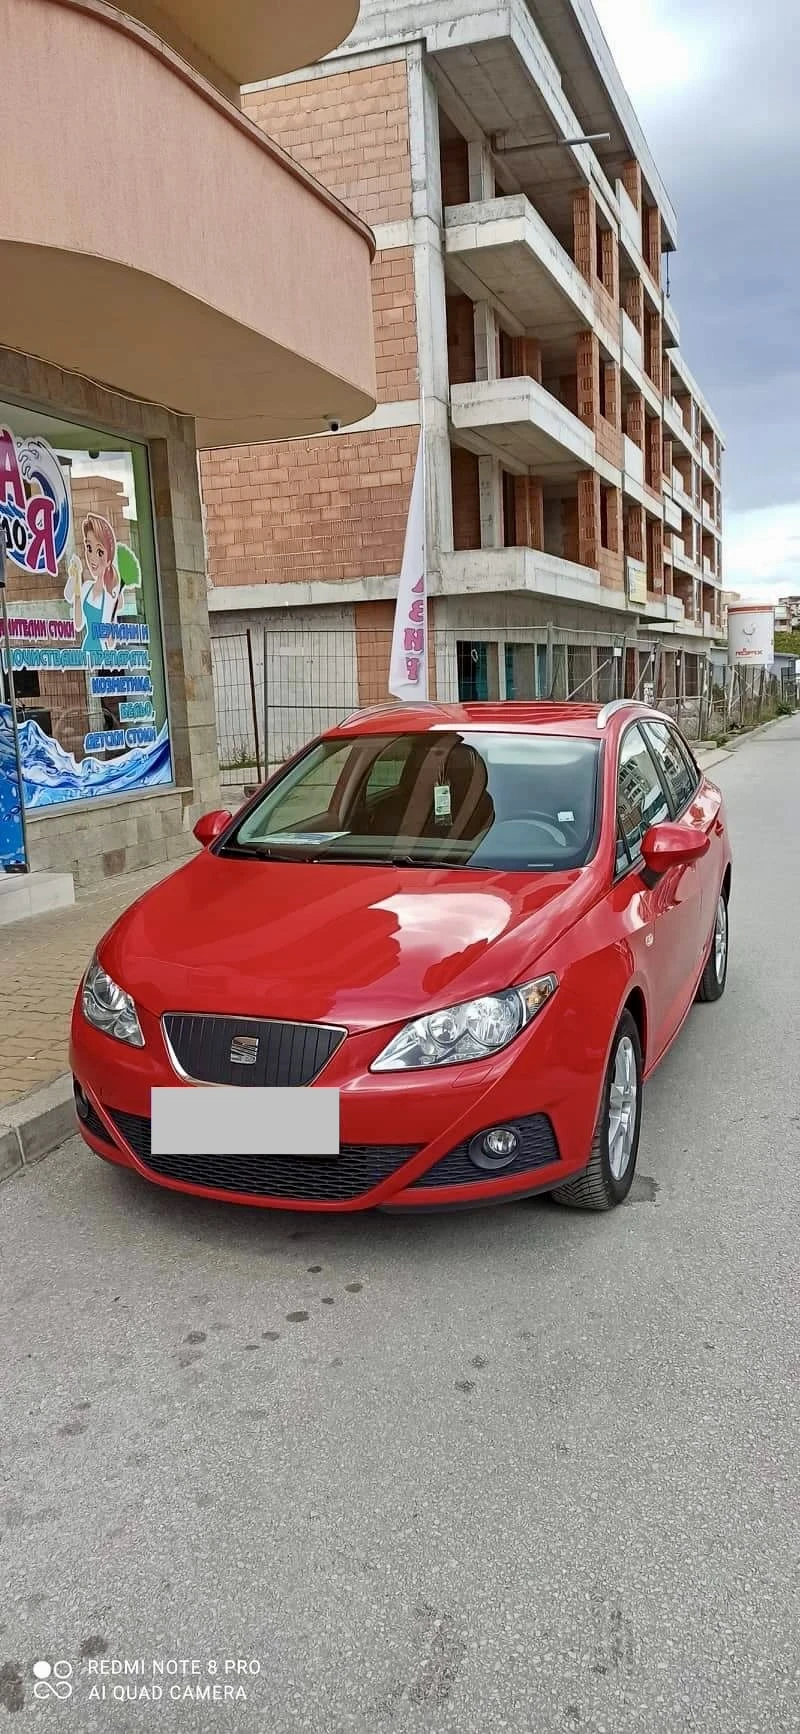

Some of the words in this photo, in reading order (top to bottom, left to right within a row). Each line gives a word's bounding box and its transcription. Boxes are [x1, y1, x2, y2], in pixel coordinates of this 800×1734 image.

[48, 620, 74, 639] СТОКИ
[85, 731, 124, 750] ДЕТСКИ
[126, 727, 156, 746] СТОКИ
